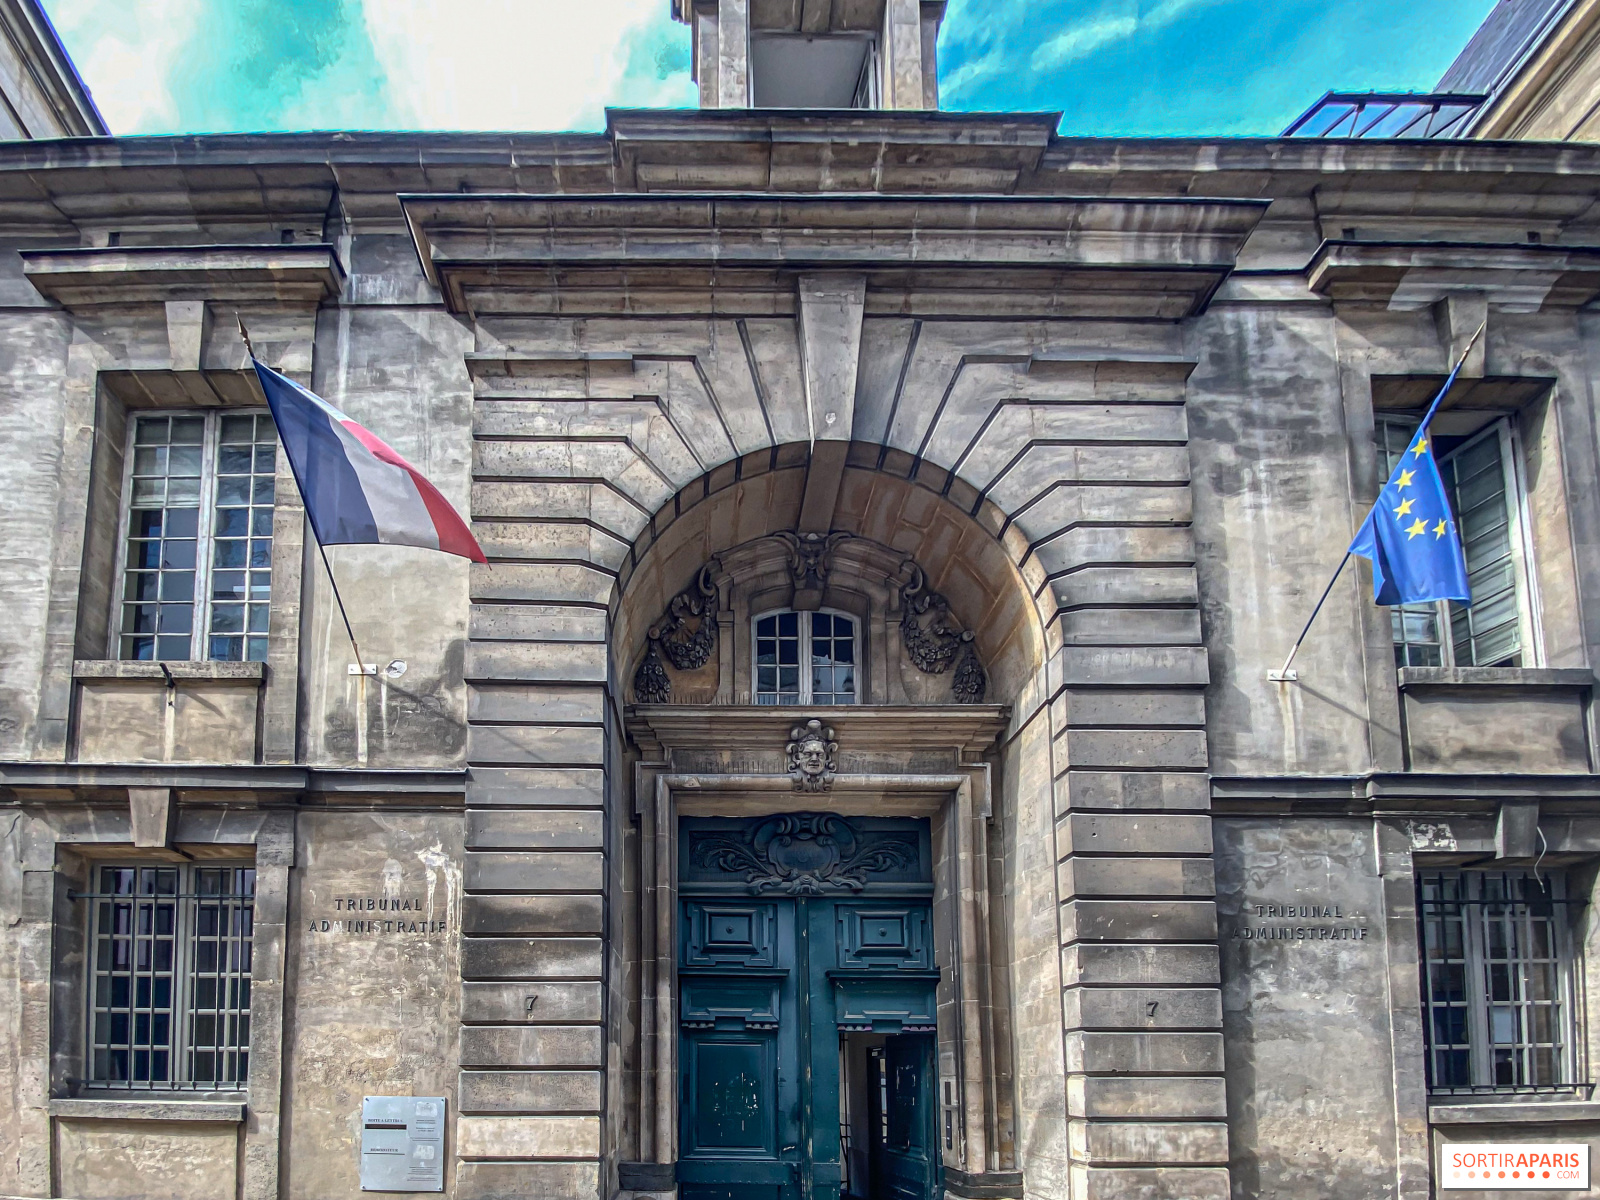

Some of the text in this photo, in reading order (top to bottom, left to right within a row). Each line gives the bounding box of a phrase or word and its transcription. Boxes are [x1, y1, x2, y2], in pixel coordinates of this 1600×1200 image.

[334, 899, 422, 911] TRIBUNAL
[1254, 904, 1343, 918] TRIBUNAL
[308, 920, 447, 933] ADMINISTRATIF
[1231, 926, 1368, 940] ADMINISTRATIF
[526, 995, 539, 1011] 7
[1146, 1000, 1159, 1017] 7
